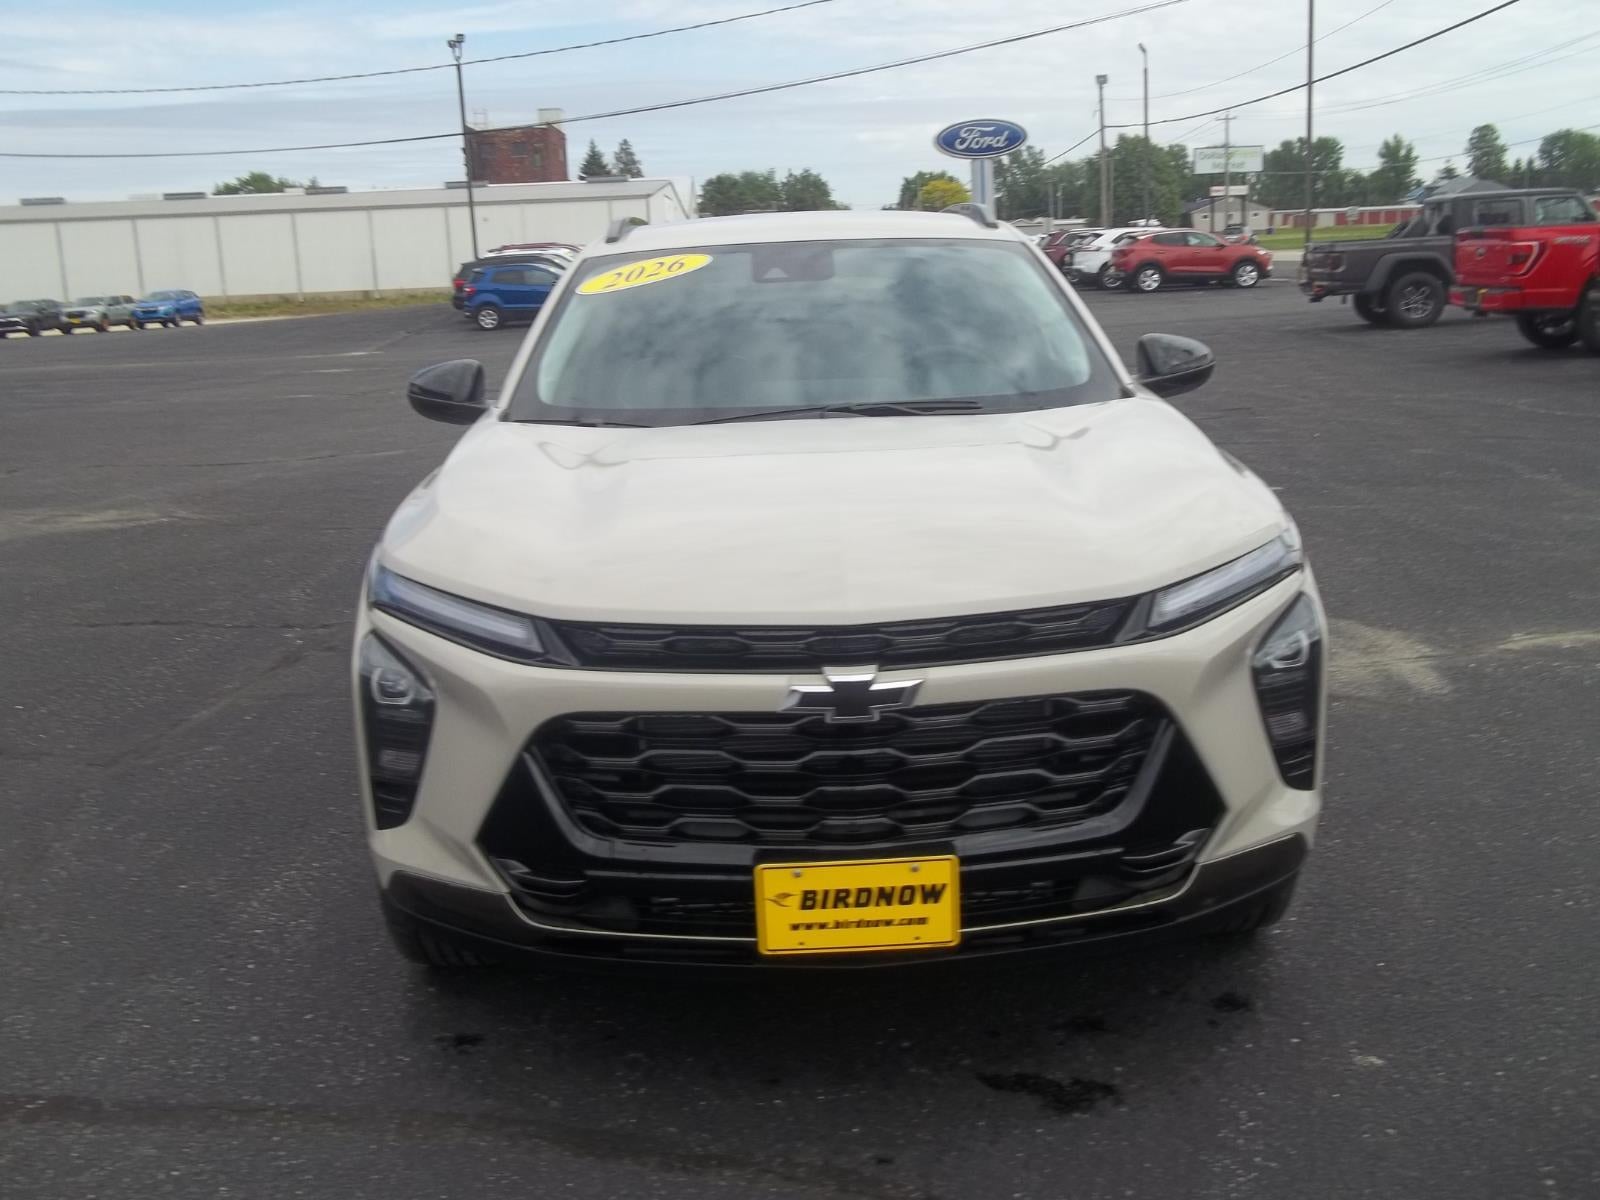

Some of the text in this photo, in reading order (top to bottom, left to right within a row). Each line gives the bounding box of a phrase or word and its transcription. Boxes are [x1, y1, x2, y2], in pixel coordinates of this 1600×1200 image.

[955, 126, 1009, 150] Ford
[603, 258, 686, 289] 2026
[800, 883, 948, 911] BIRDNOW
[790, 916, 929, 931] www.birdnow.com
